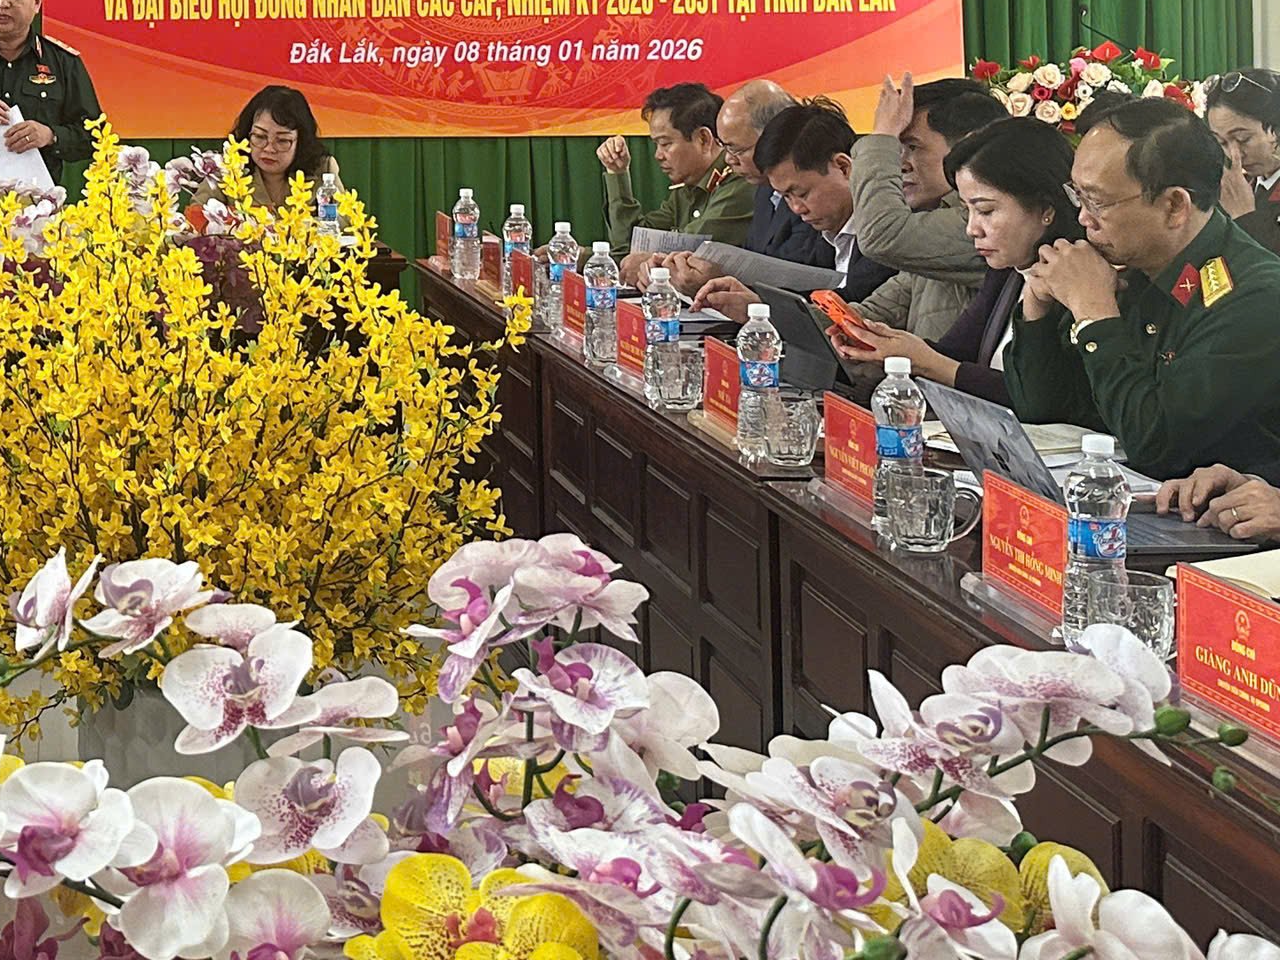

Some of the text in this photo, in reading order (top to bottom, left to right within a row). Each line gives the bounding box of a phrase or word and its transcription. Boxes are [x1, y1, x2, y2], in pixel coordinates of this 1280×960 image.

[288, 38, 704, 69] Đắk Lắk, ngày 08 tháng 01 năm 2026
[1233, 665, 1258, 690] ANH
